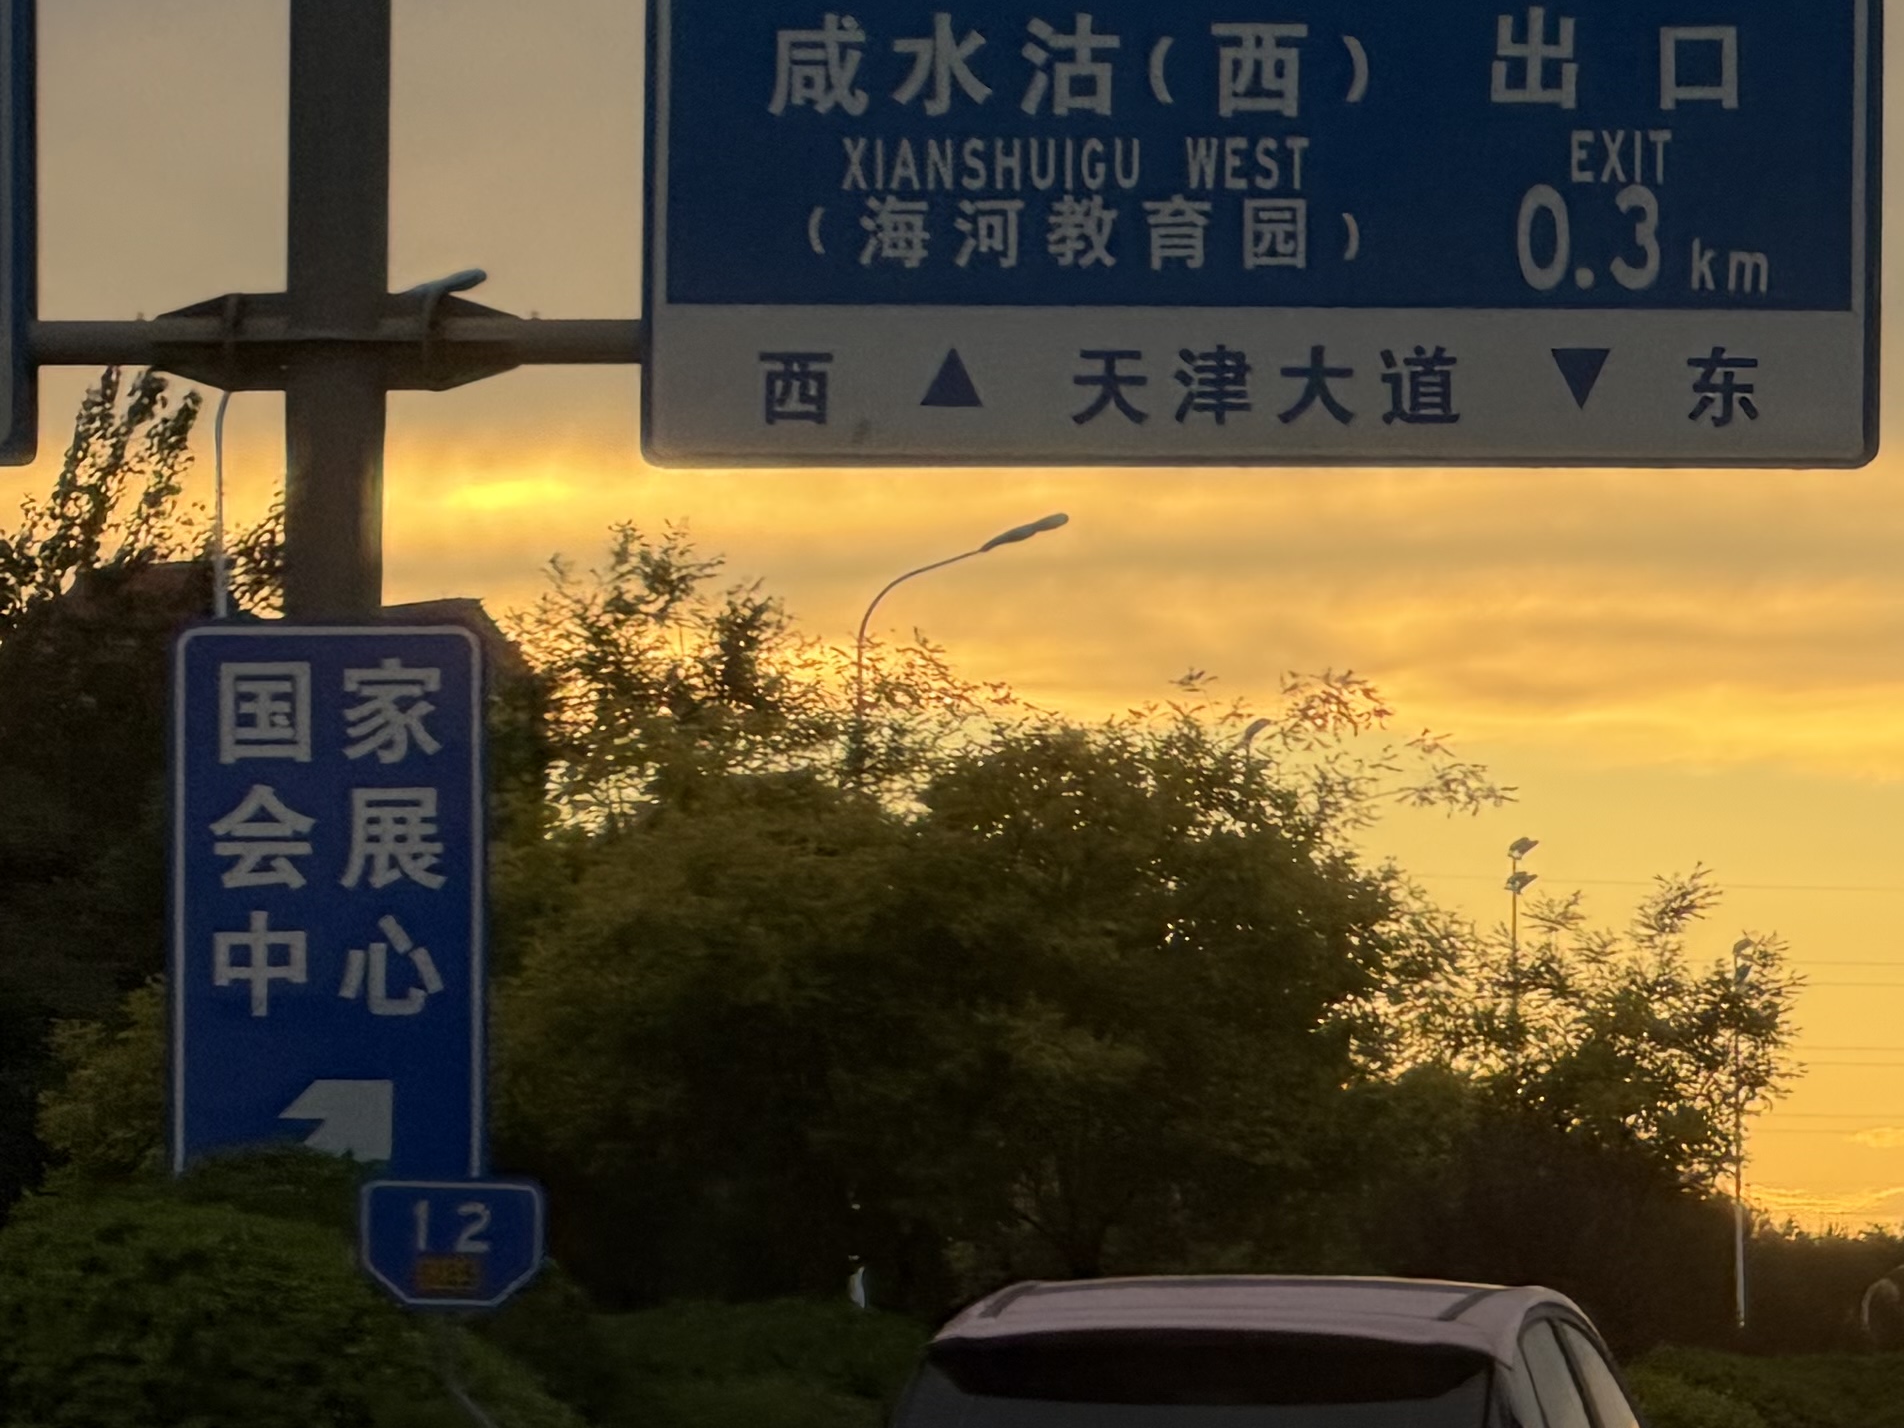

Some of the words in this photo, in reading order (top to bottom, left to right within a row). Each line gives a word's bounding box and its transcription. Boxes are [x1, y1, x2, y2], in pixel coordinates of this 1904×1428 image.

[1490, 5, 1739, 111] 出口
[841, 137, 1140, 191] XIANSHUIGU
[1185, 136, 1310, 190] WEST
[1570, 129, 1672, 183] EXIT
[1517, 184, 1664, 291] 0.3
[1690, 237, 1769, 294] km
[758, 351, 834, 426] 西
[1071, 343, 1461, 426] 天津大道
[1686, 346, 1759, 428] 东
[218, 657, 442, 765] 国家
[208, 783, 446, 889] 会展
[213, 910, 444, 1017] 中心
[413, 1199, 491, 1254] 12
